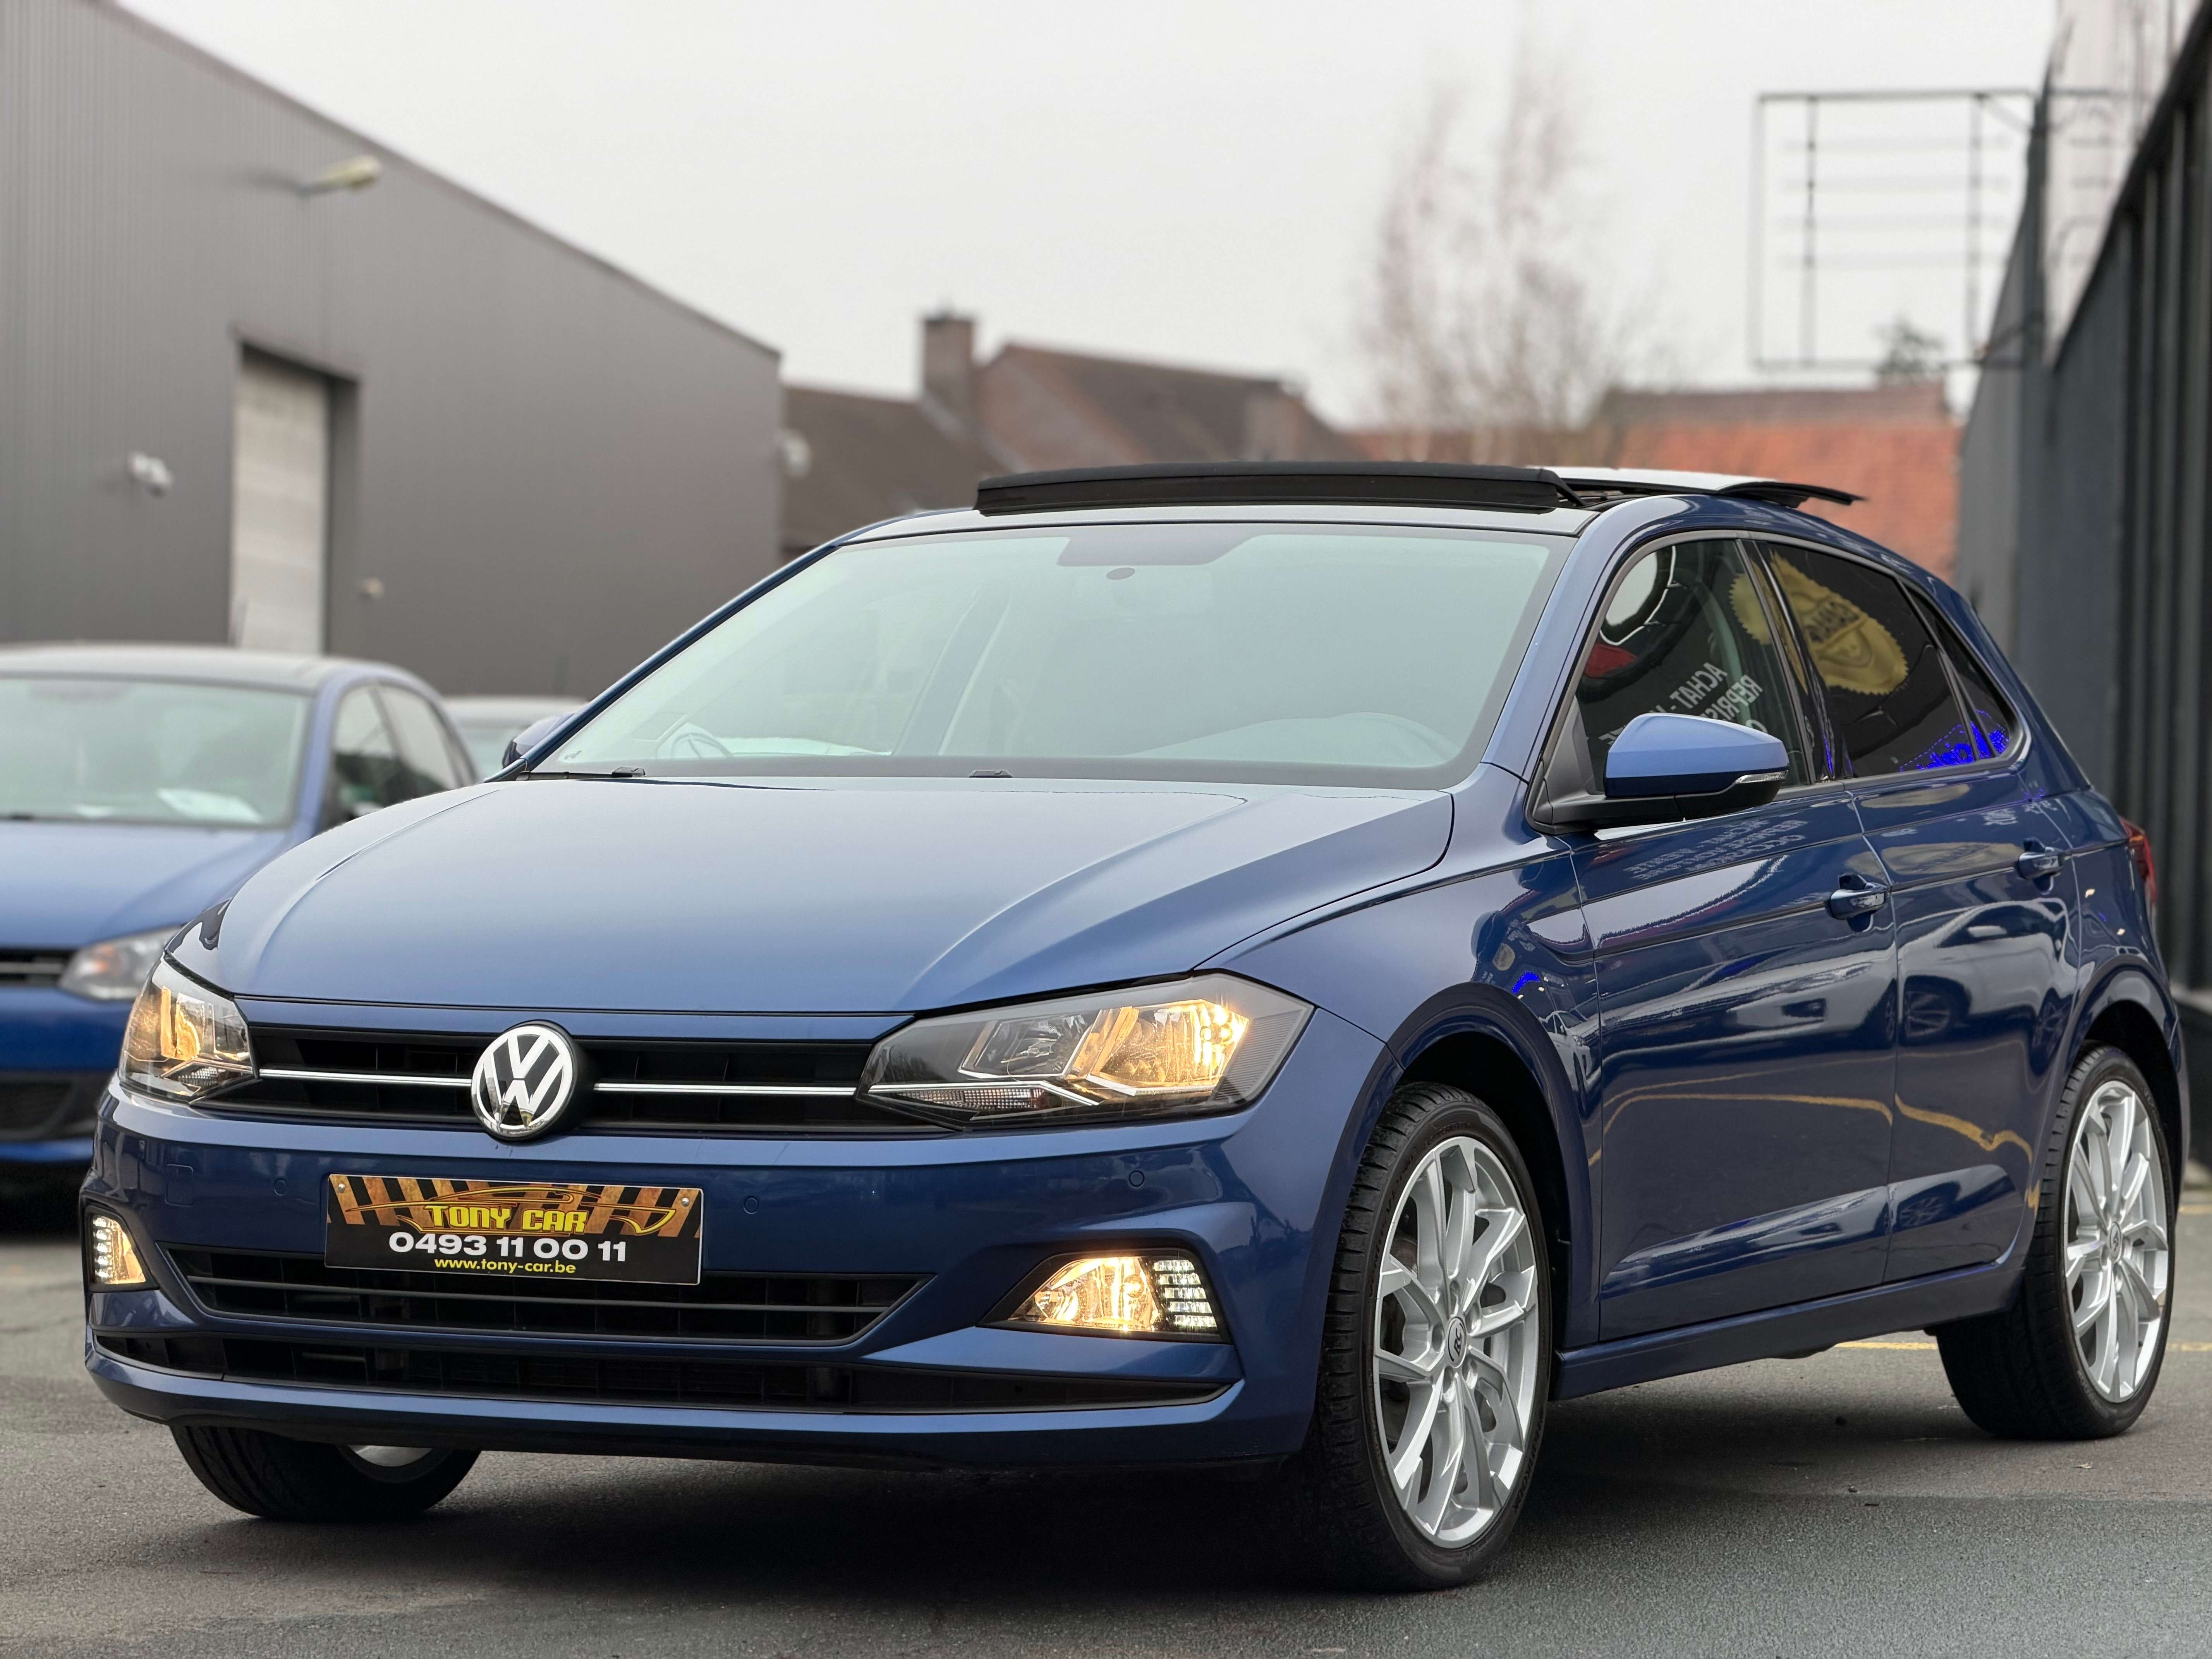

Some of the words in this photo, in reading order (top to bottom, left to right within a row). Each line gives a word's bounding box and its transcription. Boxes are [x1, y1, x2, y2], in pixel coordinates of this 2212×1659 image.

[425, 1206, 510, 1229] TONY
[522, 1209, 588, 1233] CAR
[389, 1231, 487, 1256] 0493
[496, 1237, 523, 1257] 11
[533, 1238, 588, 1260] 00
[598, 1240, 626, 1262] 11
[434, 1258, 577, 1274] www.tony-car.be
